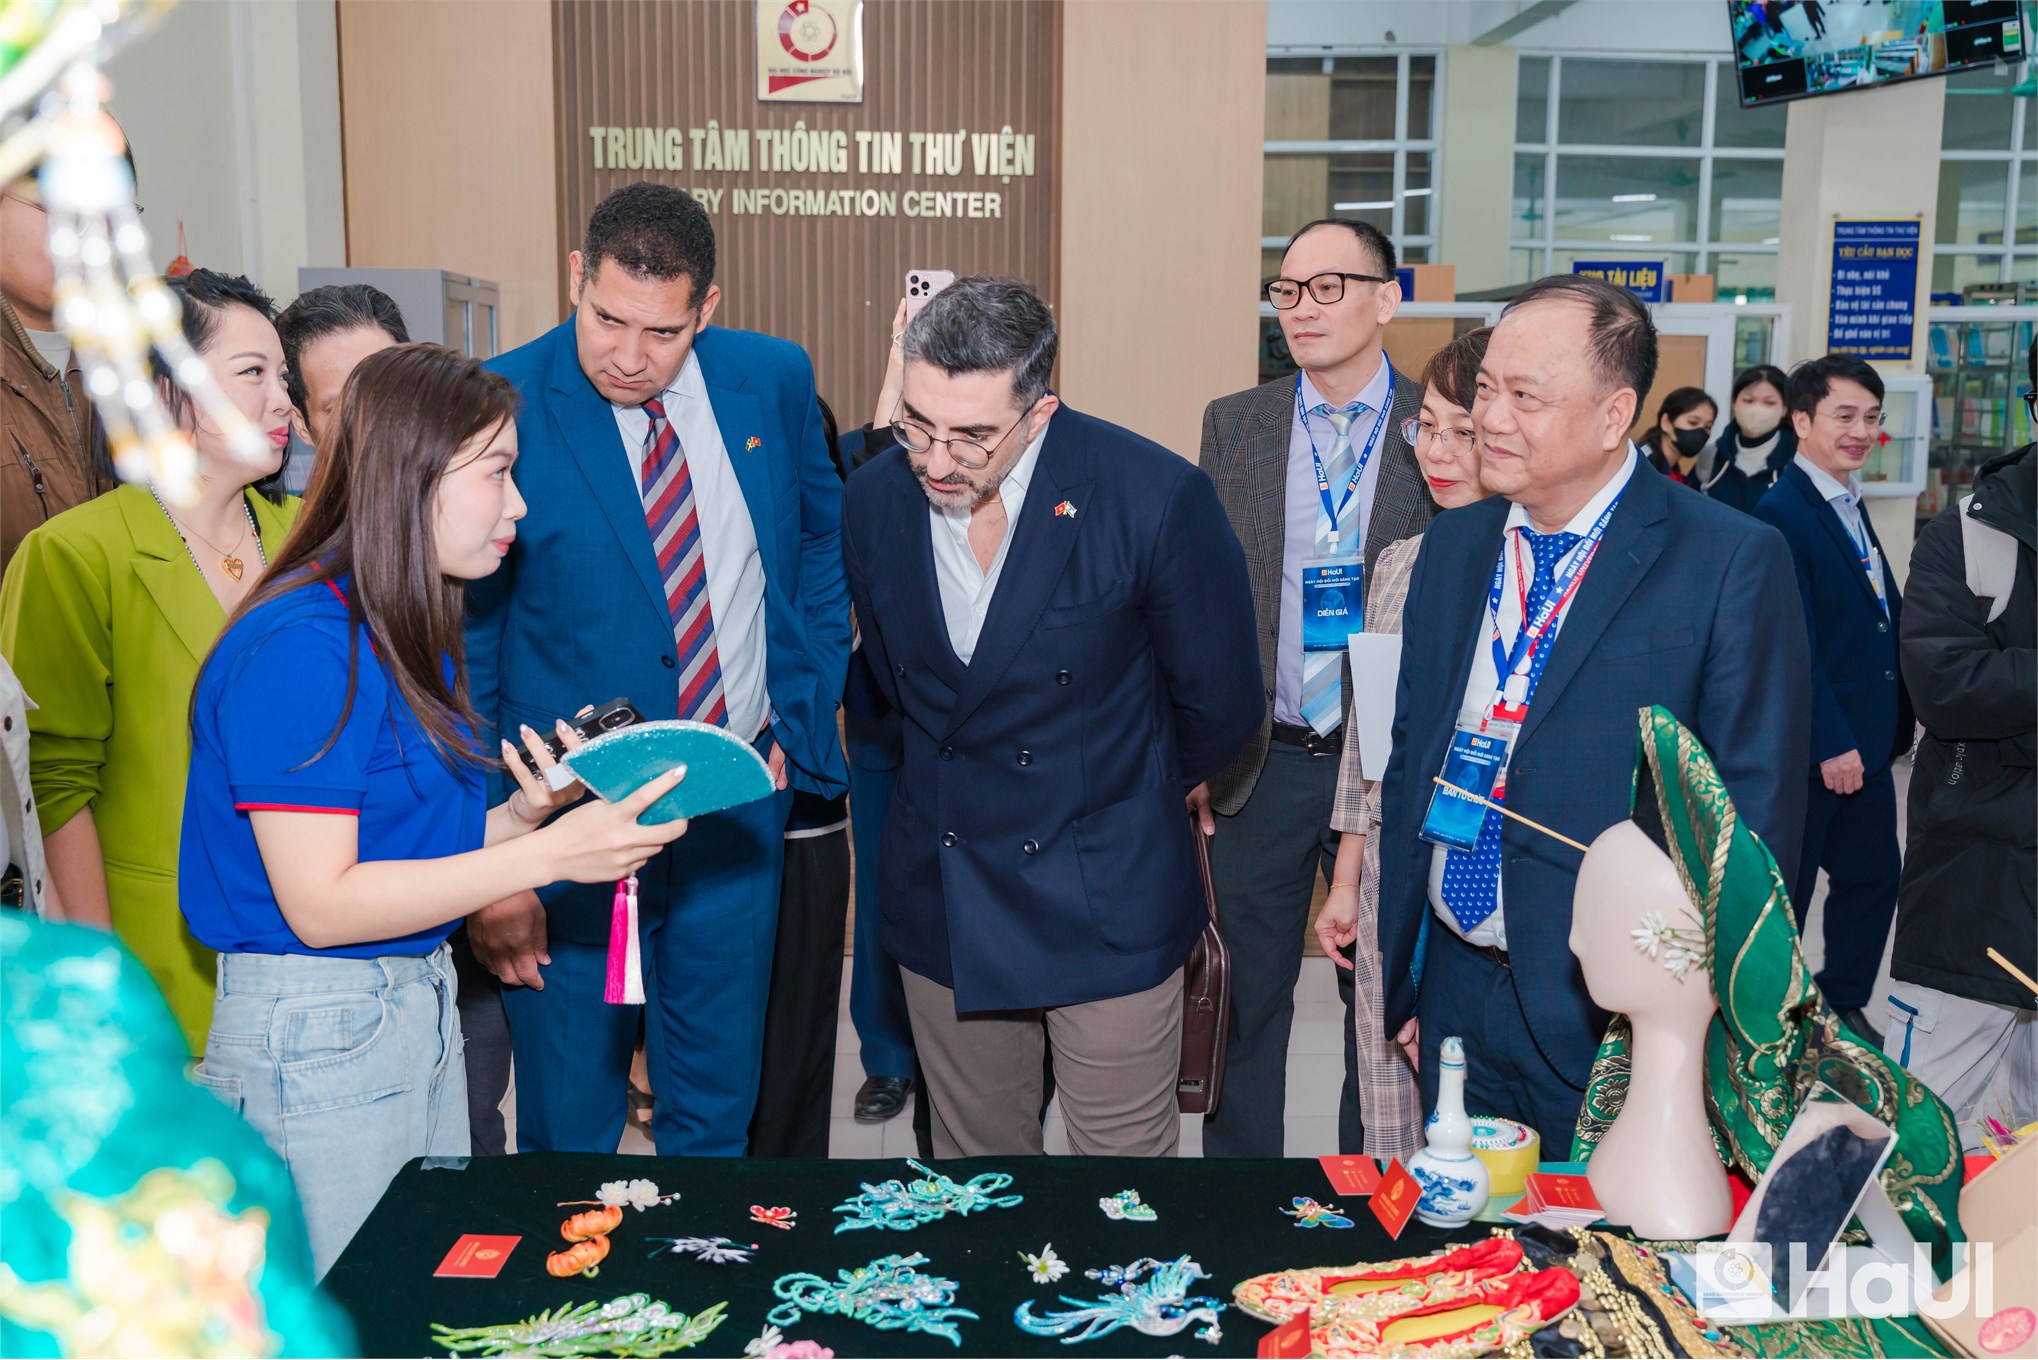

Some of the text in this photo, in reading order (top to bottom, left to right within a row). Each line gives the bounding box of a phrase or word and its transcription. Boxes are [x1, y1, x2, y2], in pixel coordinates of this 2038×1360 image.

[589, 119, 1035, 184] TRUNG TÂM THÔNG TIN THƯ VIỆN
[732, 188, 896, 217] INFORMATION
[902, 190, 1002, 218] CENTER
[1629, 267, 1656, 290] LIỆU
[1316, 462, 1326, 481] HaUI
[1352, 463, 1363, 483] HaUI
[1533, 600, 1556, 627] HaUI
[1566, 561, 1580, 579] NGÀY
[1576, 550, 1586, 562] HỘI
[1583, 538, 1594, 551] ĐỔI
[1590, 526, 1602, 539] MỚI
[1477, 739, 1491, 749] HaUI
[1948, 742, 1966, 785] xploration
[1442, 786, 1457, 797] BAN
